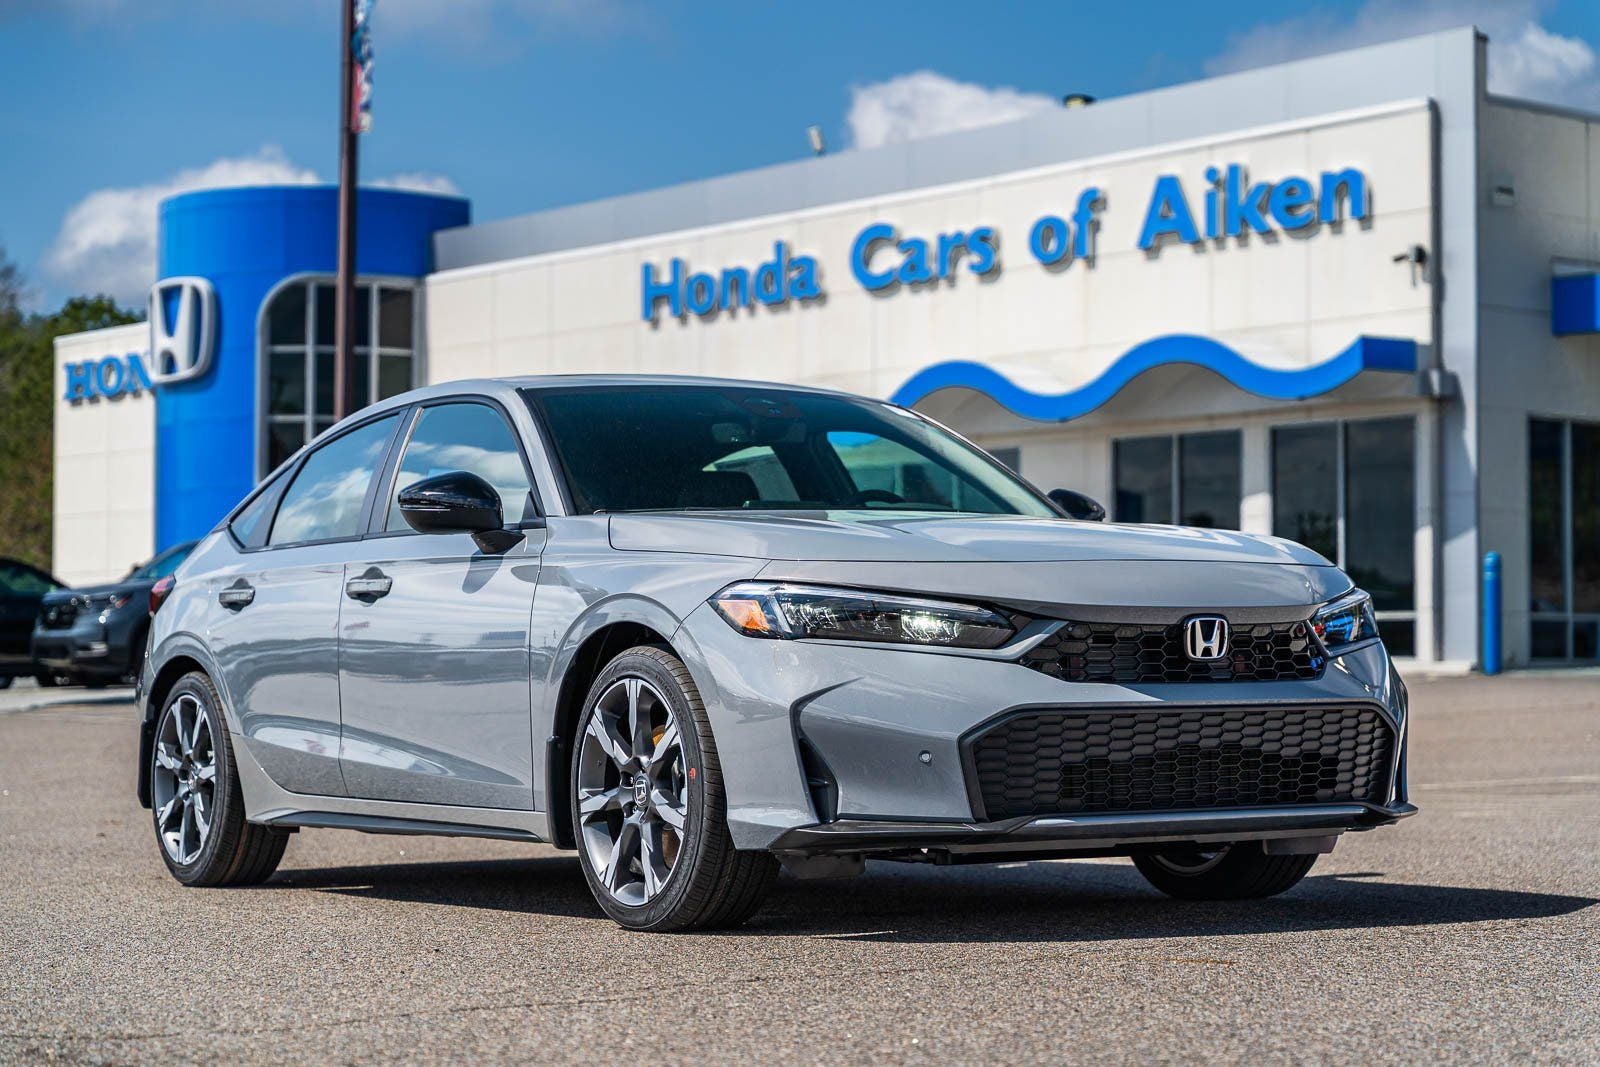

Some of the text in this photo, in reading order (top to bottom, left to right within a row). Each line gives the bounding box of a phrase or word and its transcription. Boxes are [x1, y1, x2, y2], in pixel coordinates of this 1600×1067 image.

[641, 163, 1367, 322] Honda Cars of Aiken
